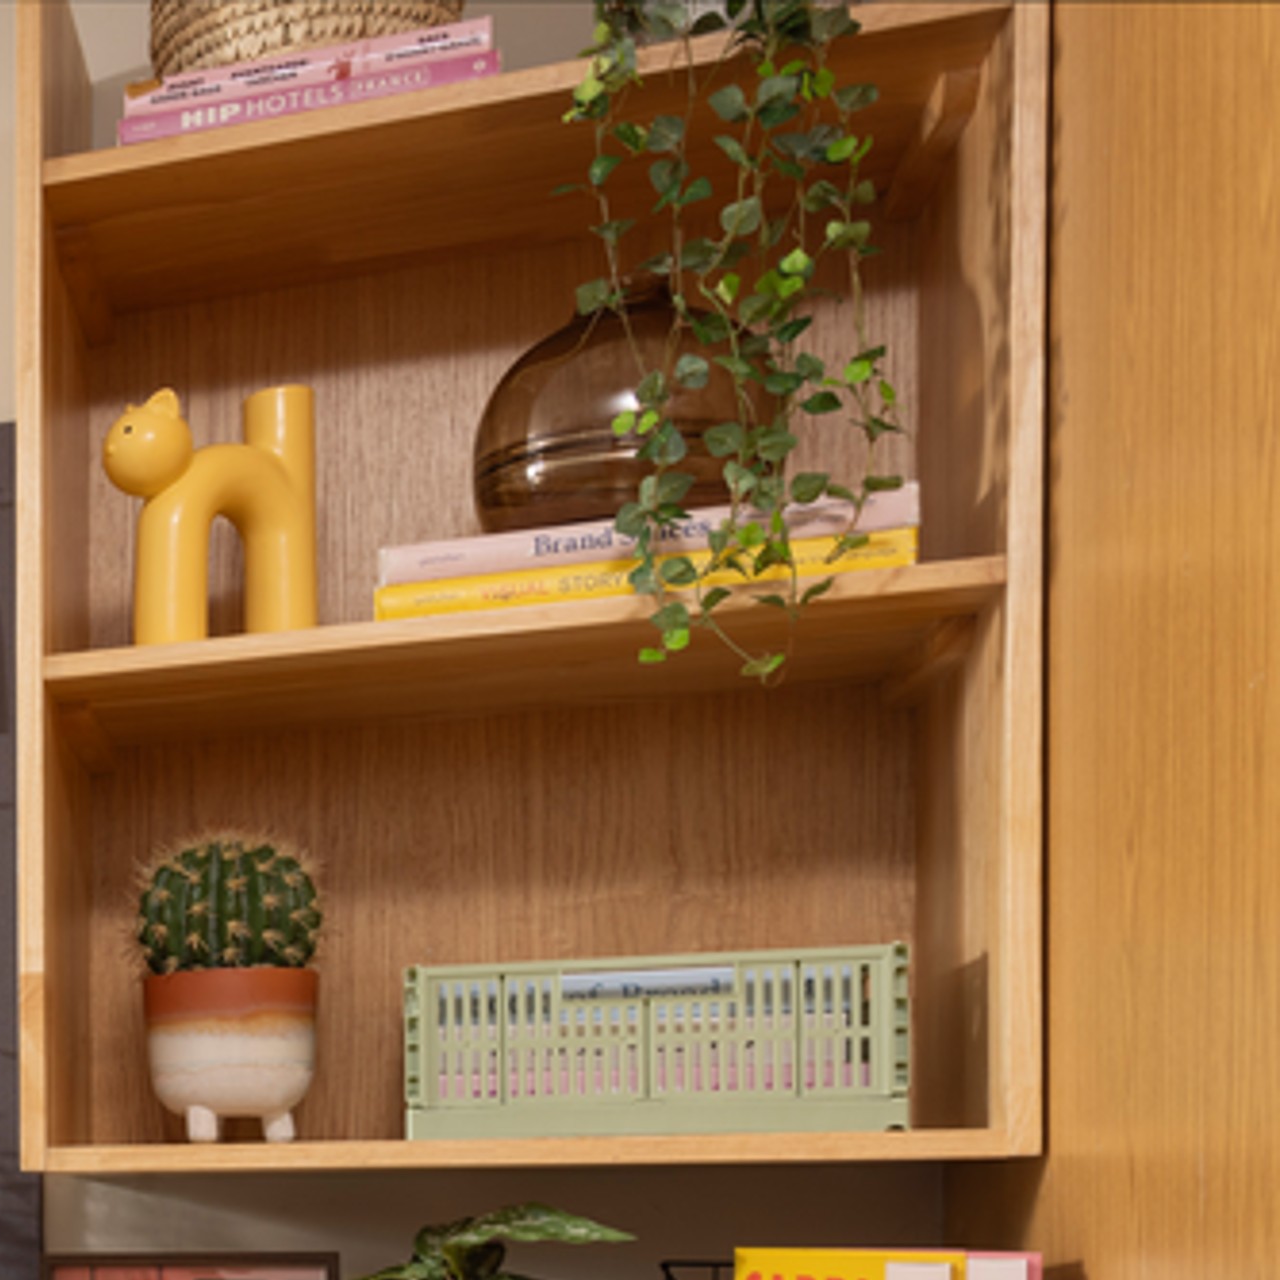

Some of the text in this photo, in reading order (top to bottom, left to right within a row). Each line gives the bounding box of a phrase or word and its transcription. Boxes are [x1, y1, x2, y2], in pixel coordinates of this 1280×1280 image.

[181, 103, 241, 129] HIP
[246, 84, 343, 117] HOTELS
[533, 527, 613, 556] Brand
